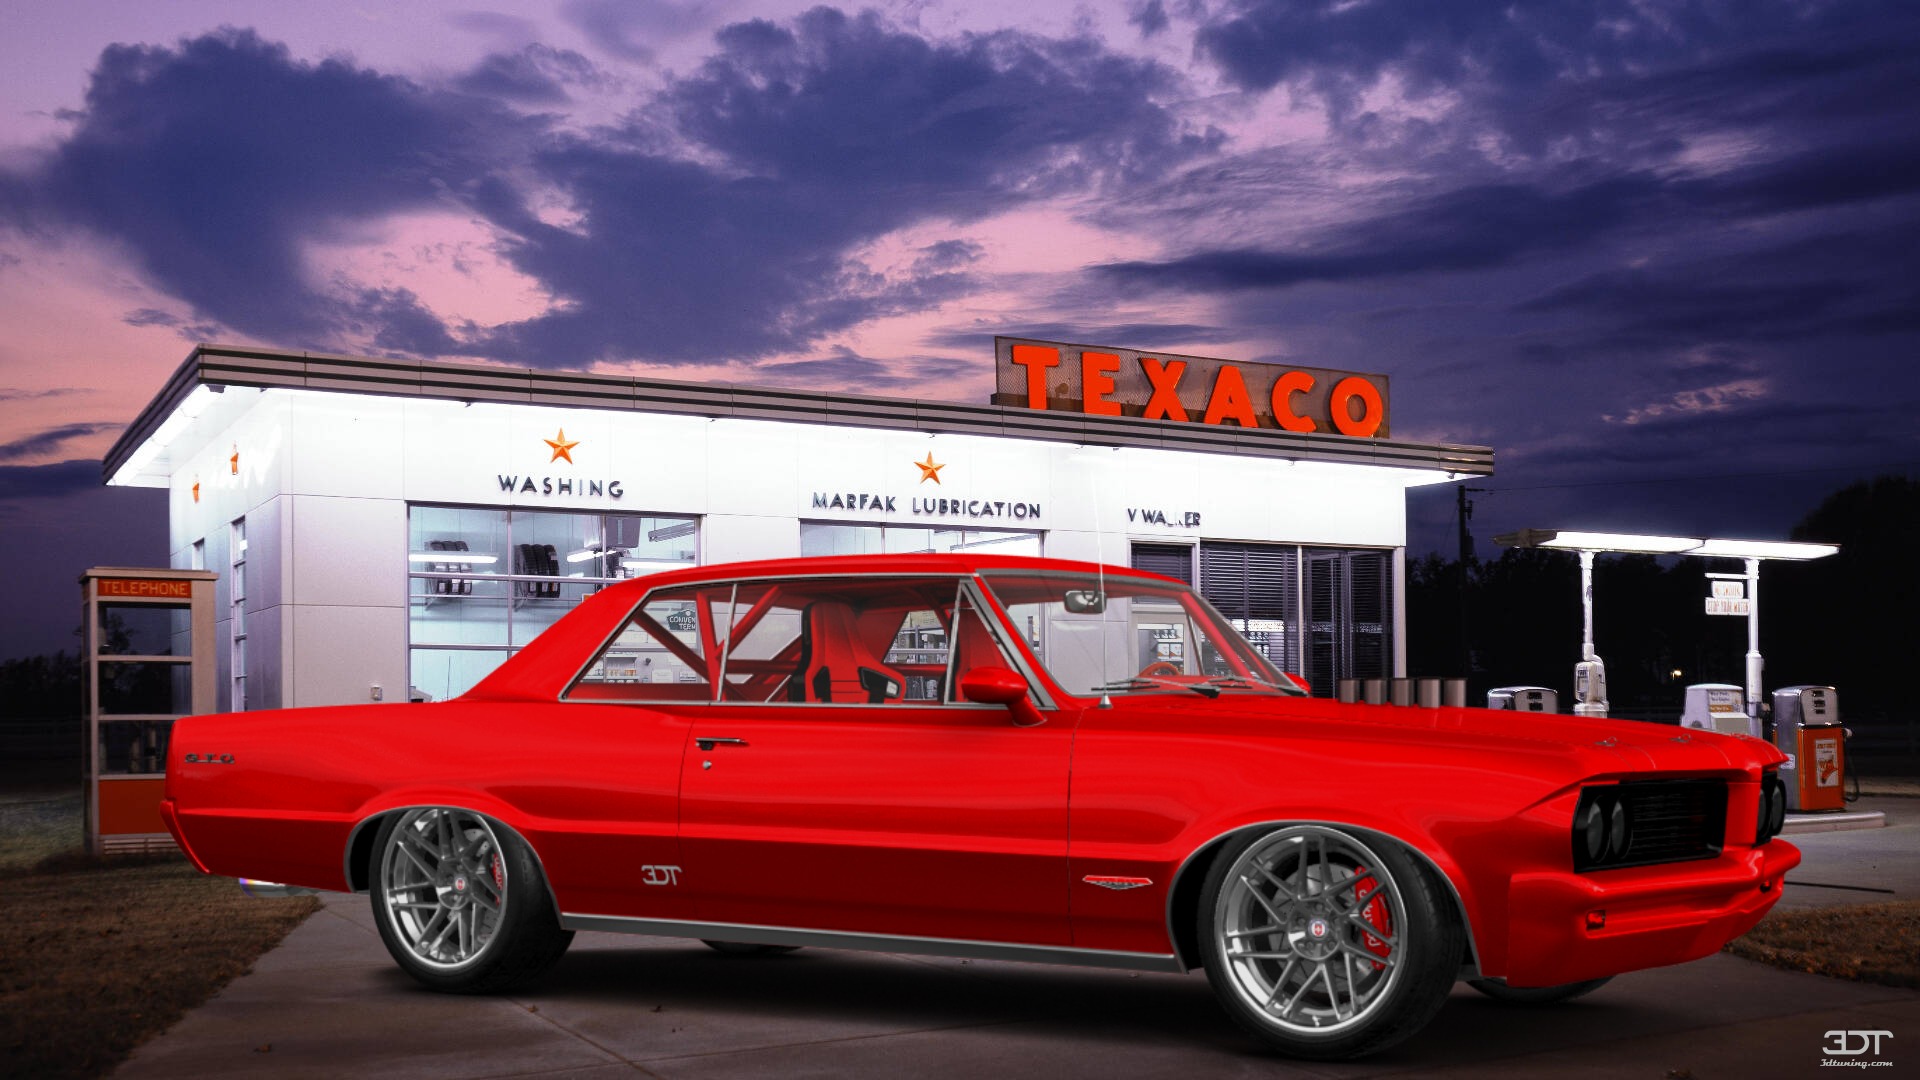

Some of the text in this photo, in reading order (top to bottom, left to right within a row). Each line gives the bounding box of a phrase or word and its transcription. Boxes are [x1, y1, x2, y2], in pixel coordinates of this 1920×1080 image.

[1011, 344, 1384, 438] TEXACO
[497, 474, 624, 498] WASHING
[812, 491, 1041, 519] MARFAK LUBRICATION
[102, 581, 189, 596] TELEPHONE
[184, 753, 235, 764] GTO
[641, 864, 682, 886] 3DT
